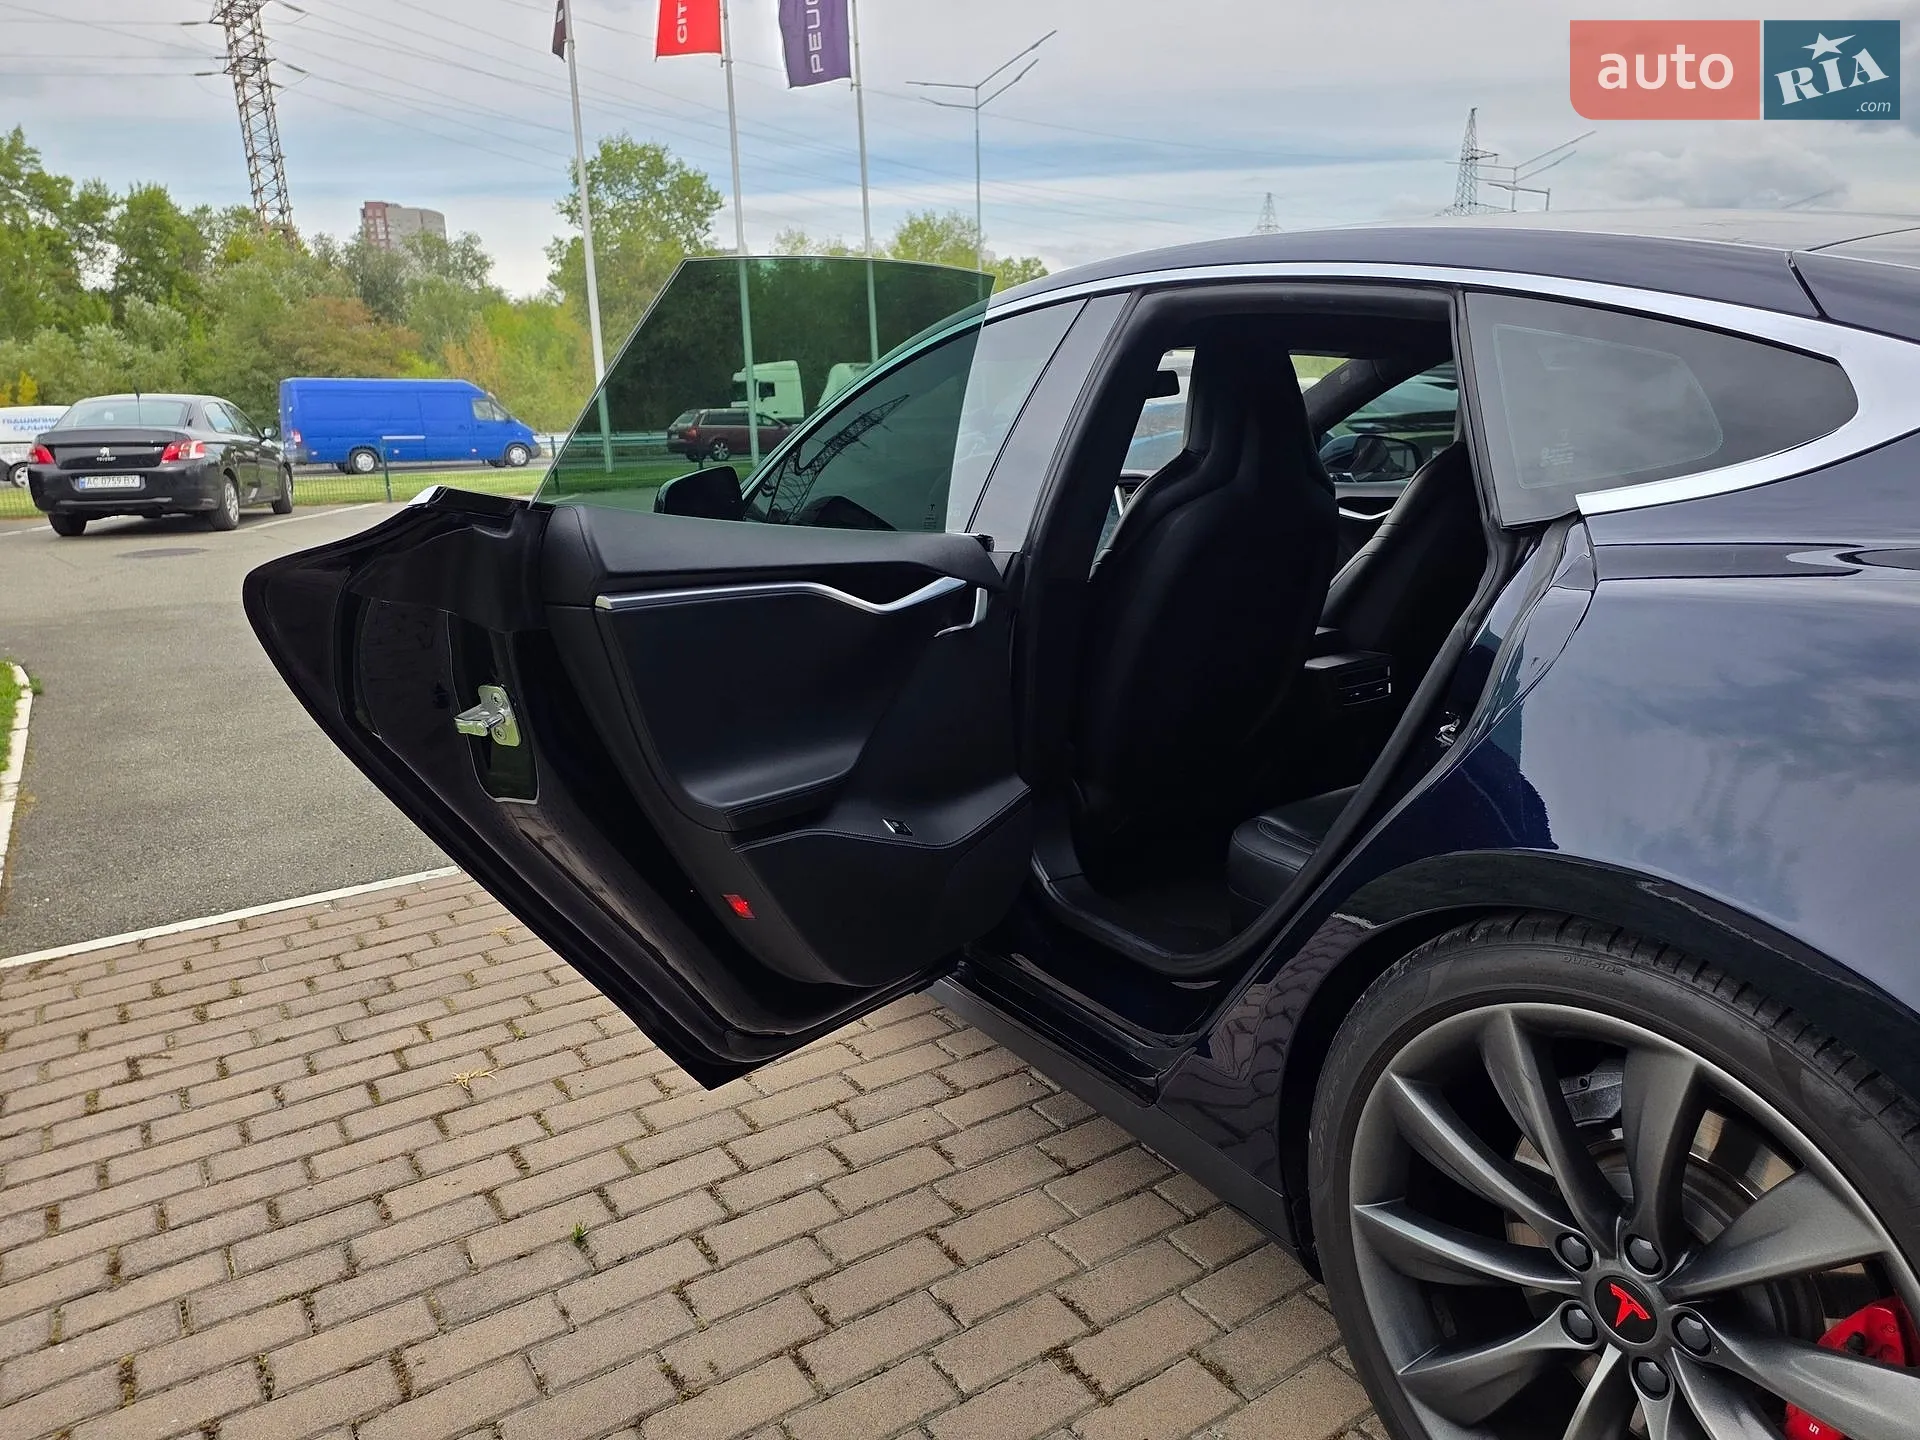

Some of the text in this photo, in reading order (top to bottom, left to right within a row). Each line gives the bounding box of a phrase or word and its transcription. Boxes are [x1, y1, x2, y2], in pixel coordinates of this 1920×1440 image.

[676, 0, 688, 44] CIT
[87, 477, 99, 487] AC
[124, 476, 137, 486] BX
